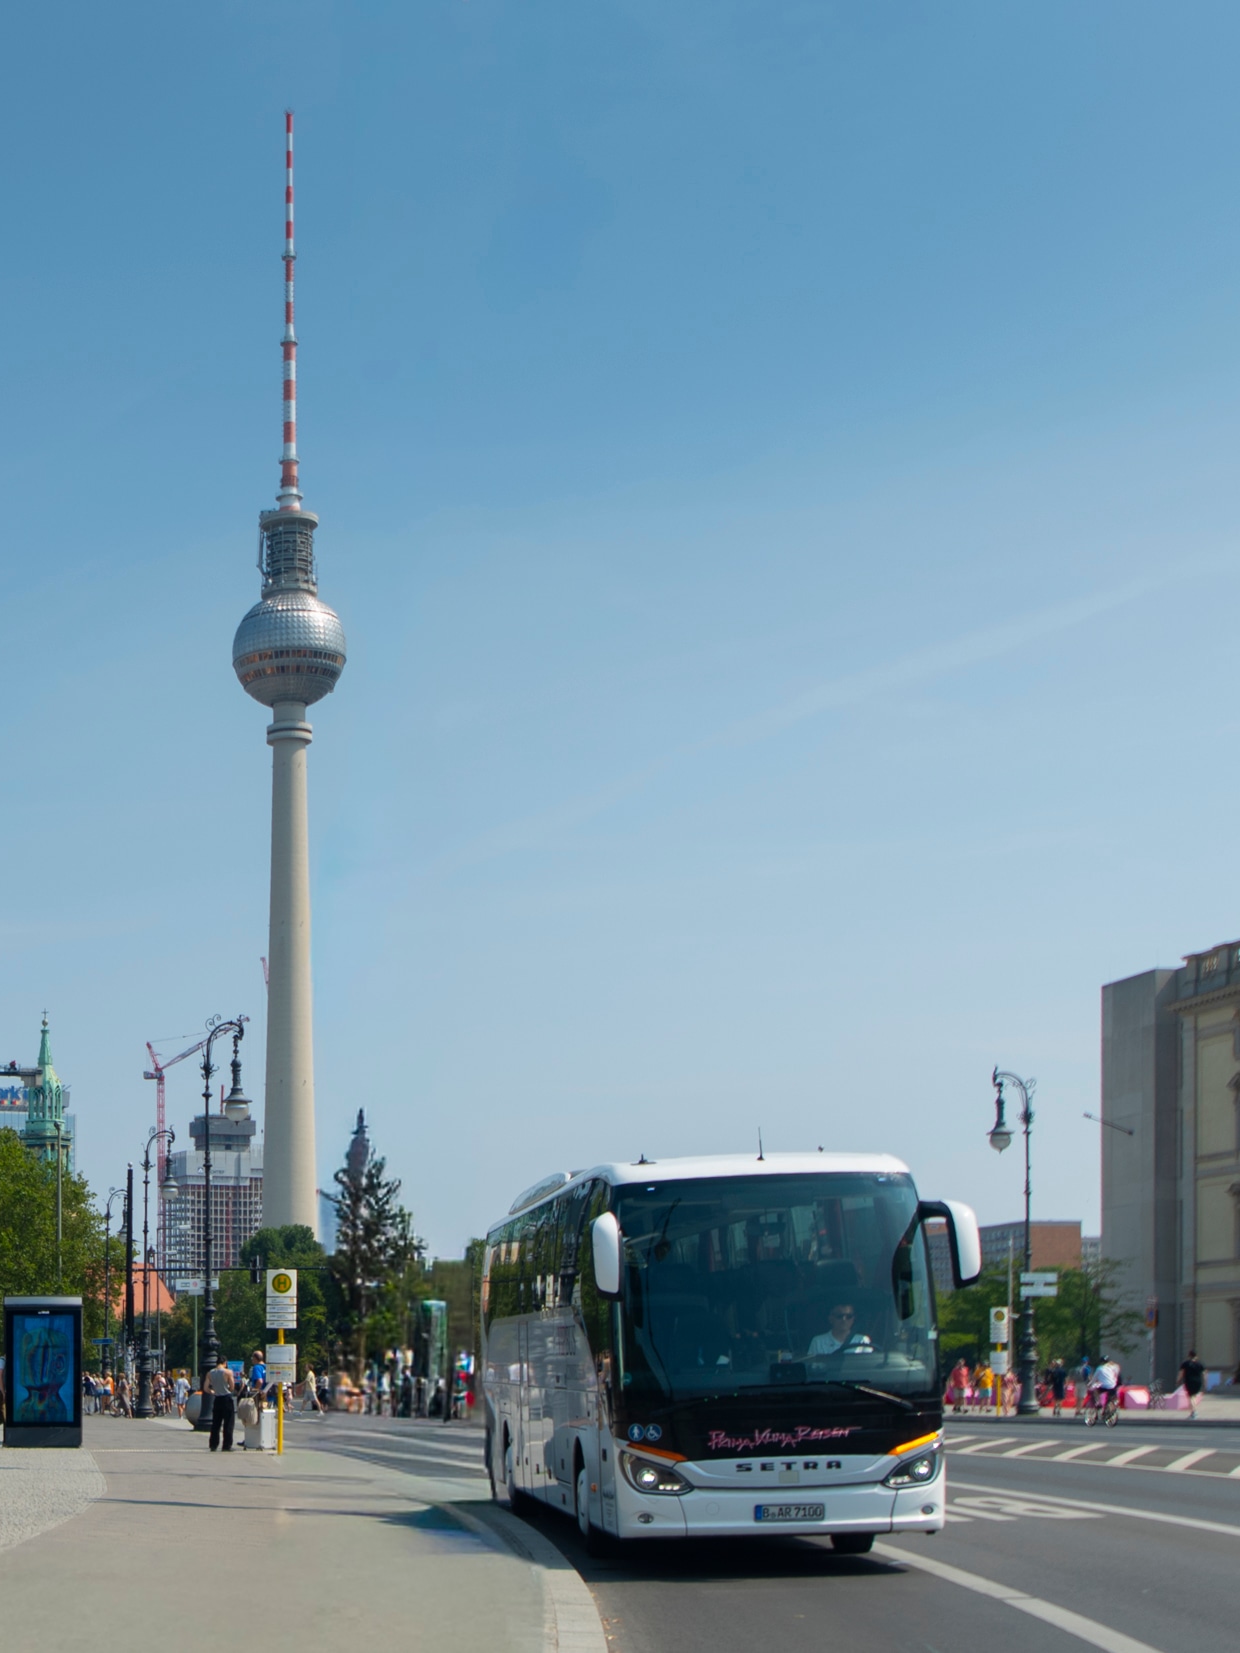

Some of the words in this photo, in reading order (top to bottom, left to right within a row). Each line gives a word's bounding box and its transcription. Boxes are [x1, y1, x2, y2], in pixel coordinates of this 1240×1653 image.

[735, 1460, 842, 1473] SETRA
[778, 1507, 792, 1518] AR
[794, 1506, 822, 1517] 7100
